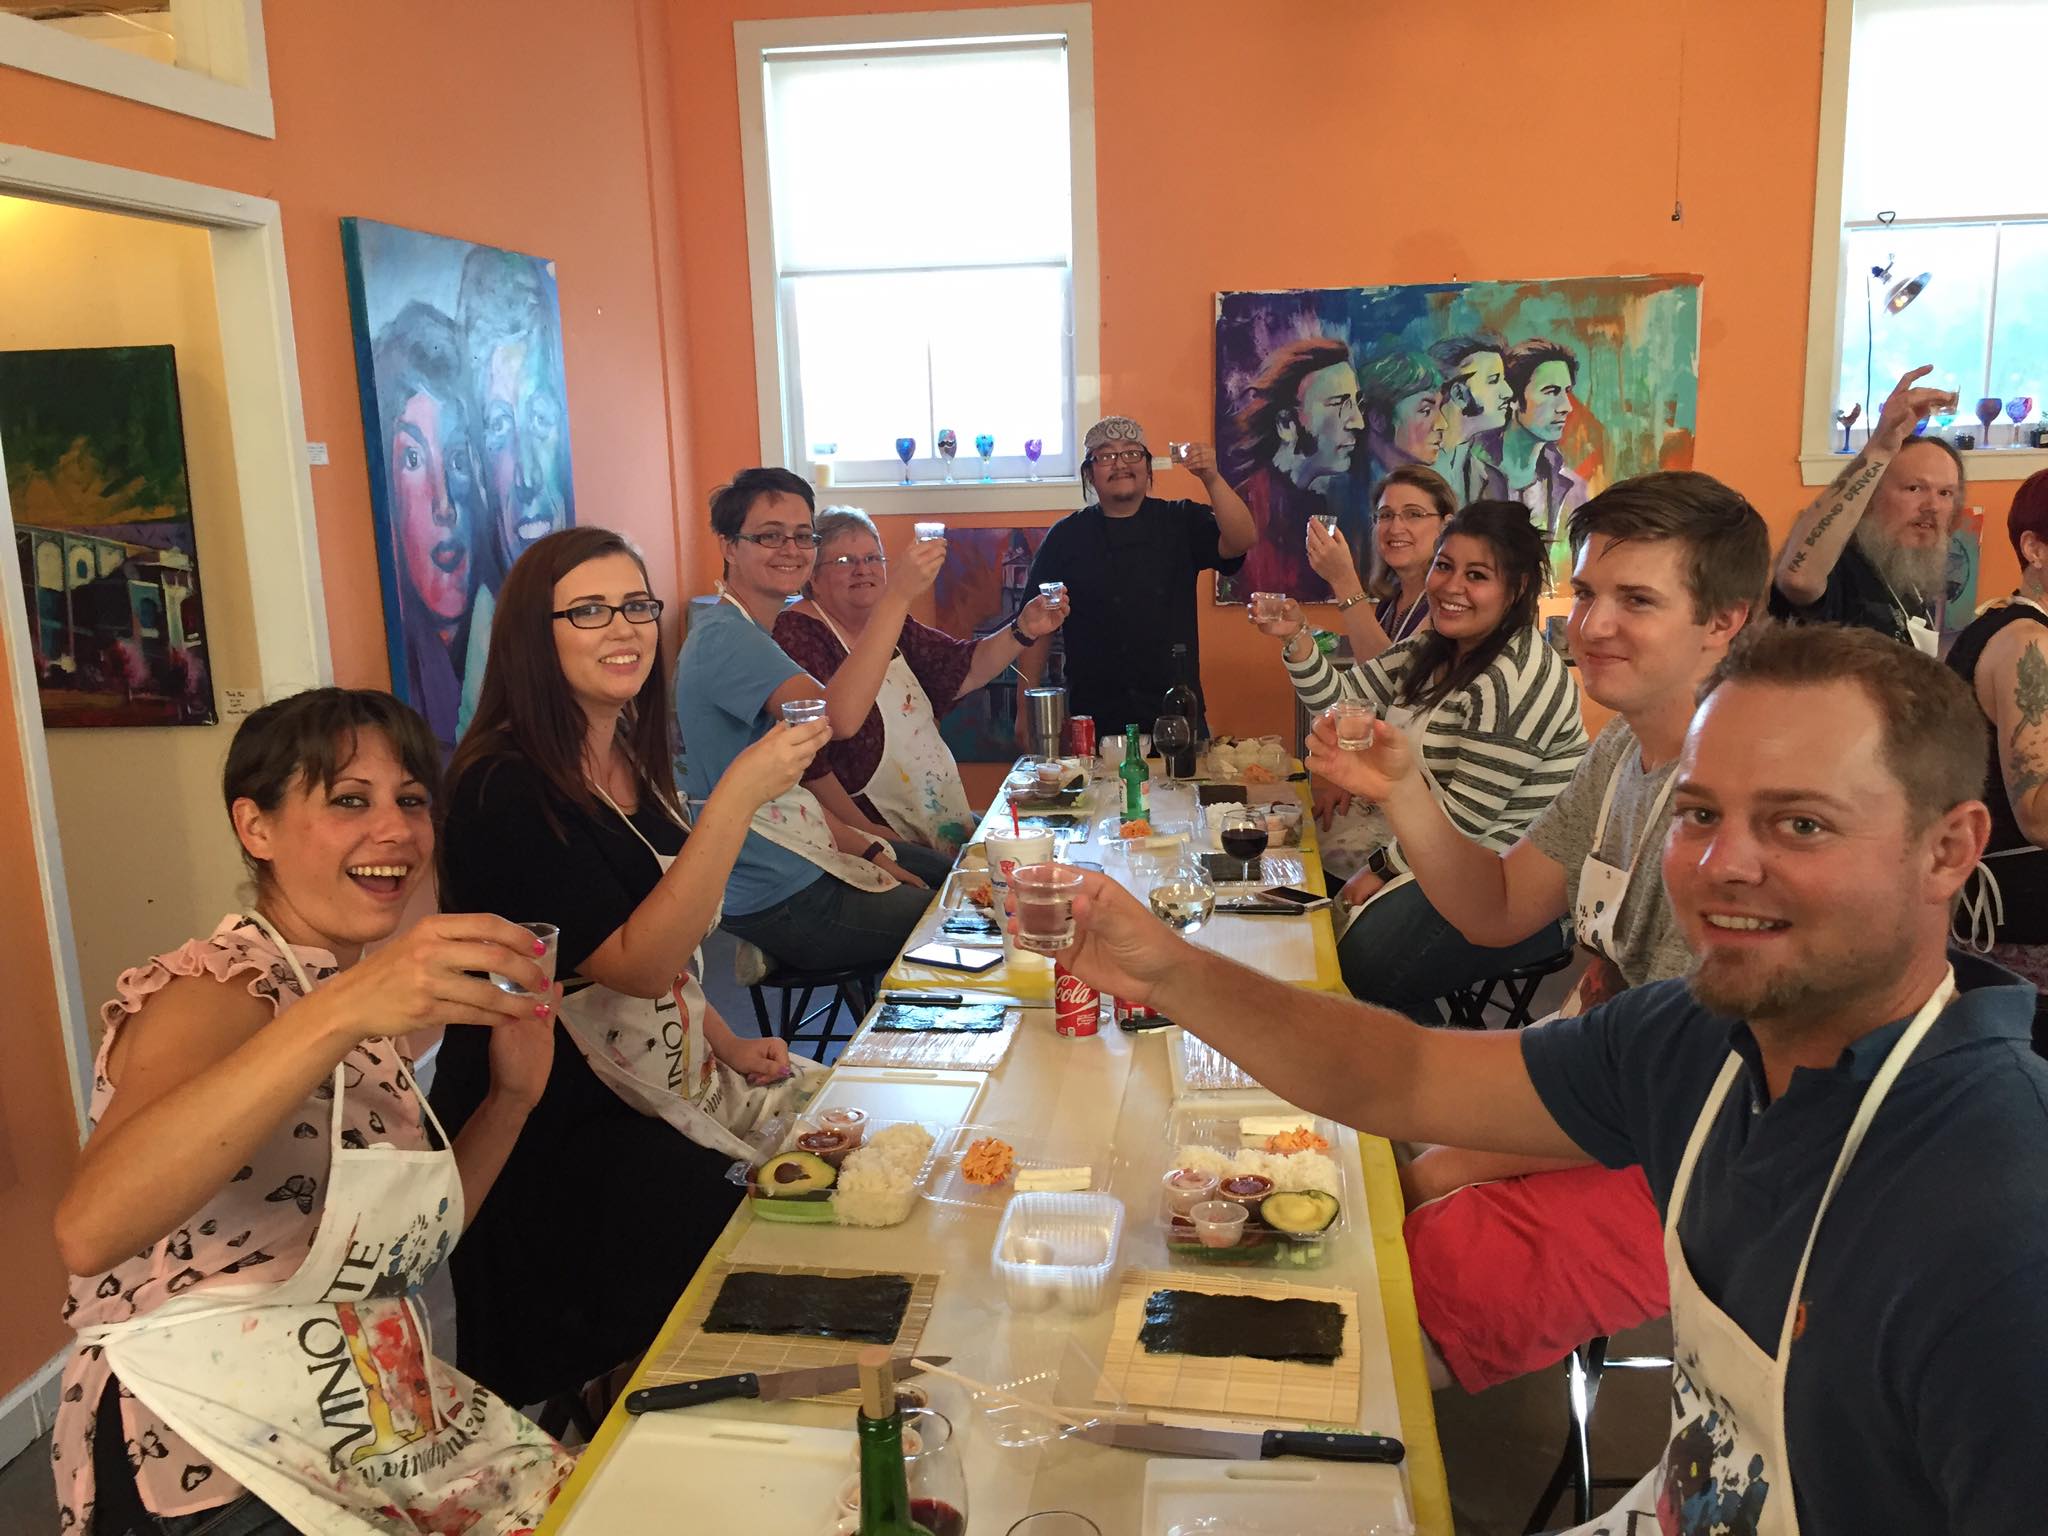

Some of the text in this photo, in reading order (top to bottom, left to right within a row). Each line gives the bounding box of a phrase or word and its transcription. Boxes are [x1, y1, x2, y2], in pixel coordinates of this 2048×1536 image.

[1788, 461, 1884, 573] FAR BEYOND DRIVEN
[1056, 974, 1091, 1004] Cola
[297, 1316, 375, 1476] VINO
